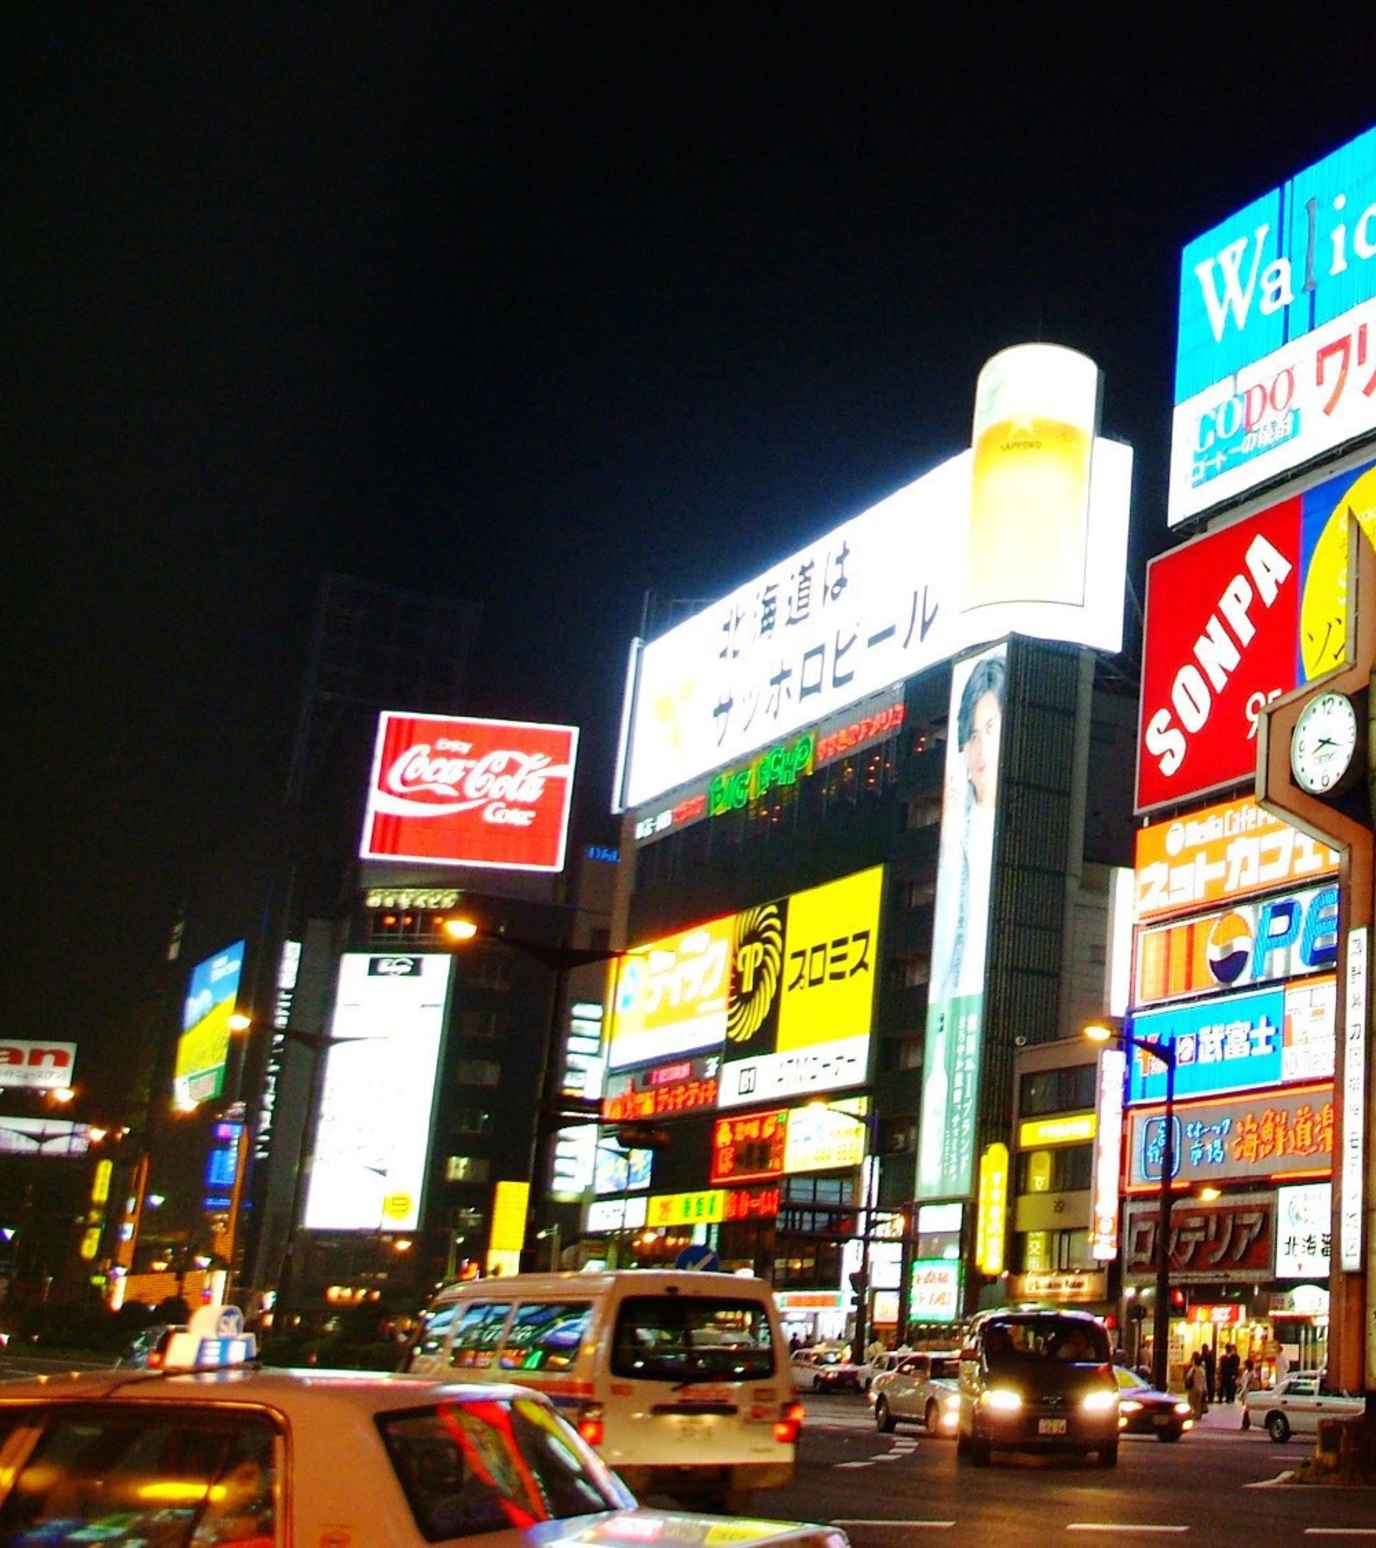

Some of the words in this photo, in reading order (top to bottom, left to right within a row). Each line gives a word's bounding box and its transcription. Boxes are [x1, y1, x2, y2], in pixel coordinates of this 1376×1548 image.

[719, 540, 851, 661] 北海道は
[1146, 534, 1292, 777] SONPA
[1322, 697, 1336, 716] 12
[387, 743, 552, 802] Coca-Cola
[708, 767, 751, 816] BIG
[756, 734, 815, 797] ECHO
[788, 930, 870, 992] プロミス
[1199, 1015, 1277, 1063] 武富士
